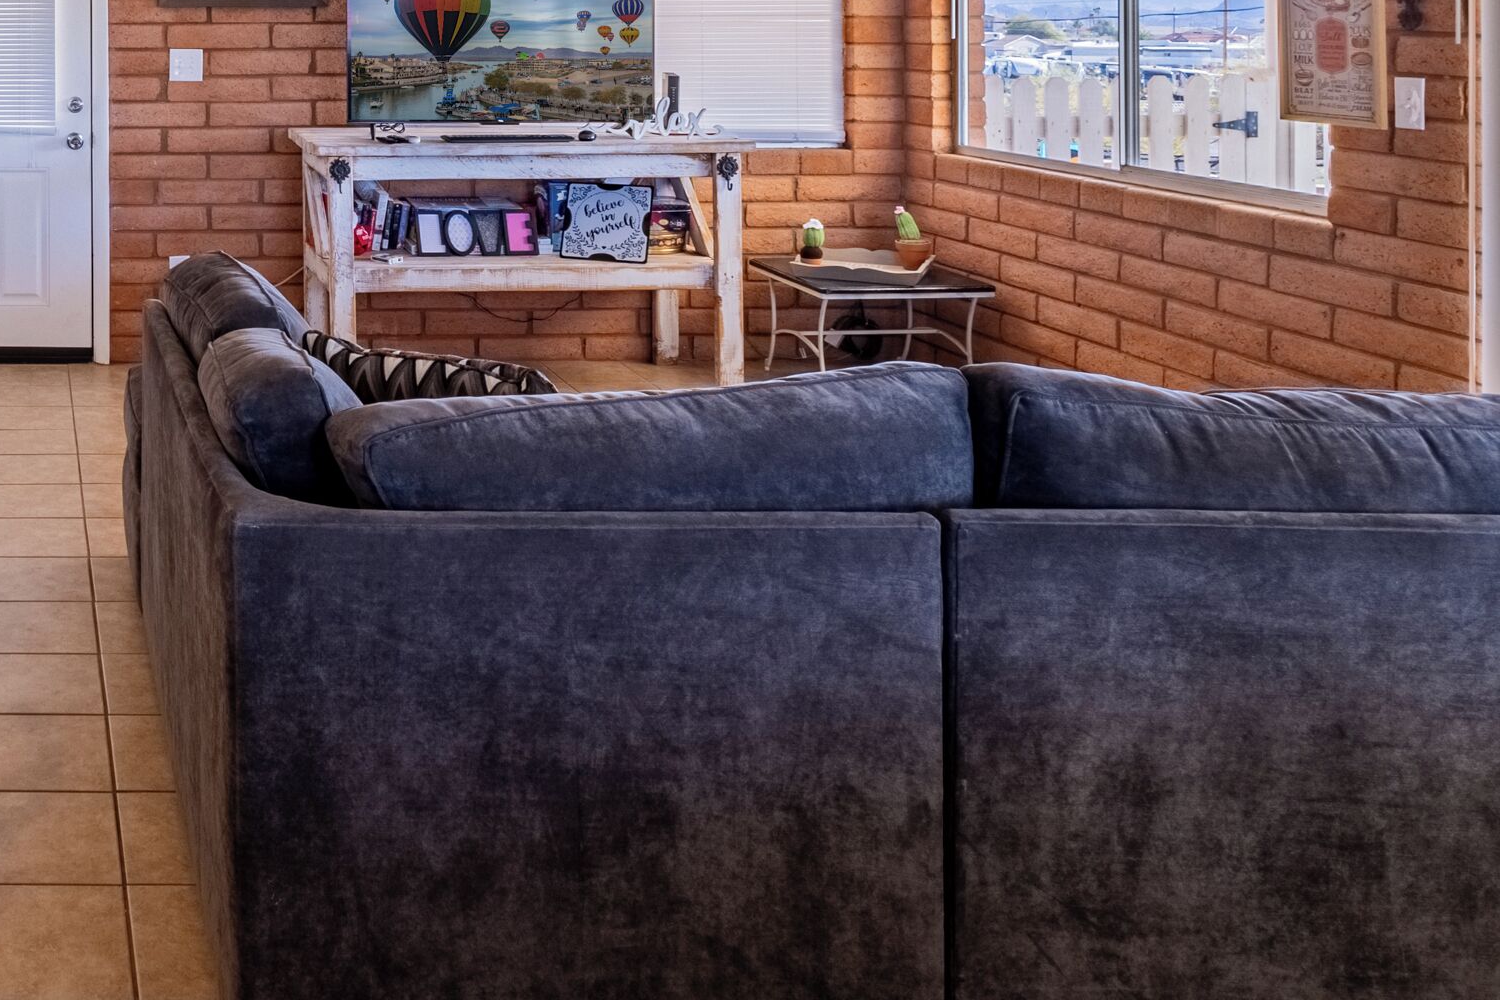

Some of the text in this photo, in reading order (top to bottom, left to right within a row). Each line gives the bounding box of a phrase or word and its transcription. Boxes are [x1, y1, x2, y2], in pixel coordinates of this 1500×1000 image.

[1294, 55, 1314, 64] MILK
[584, 199, 625, 218] believe
[601, 213, 616, 222] in
[415, 208, 539, 257] LOVE
[586, 213, 637, 242] yourself
